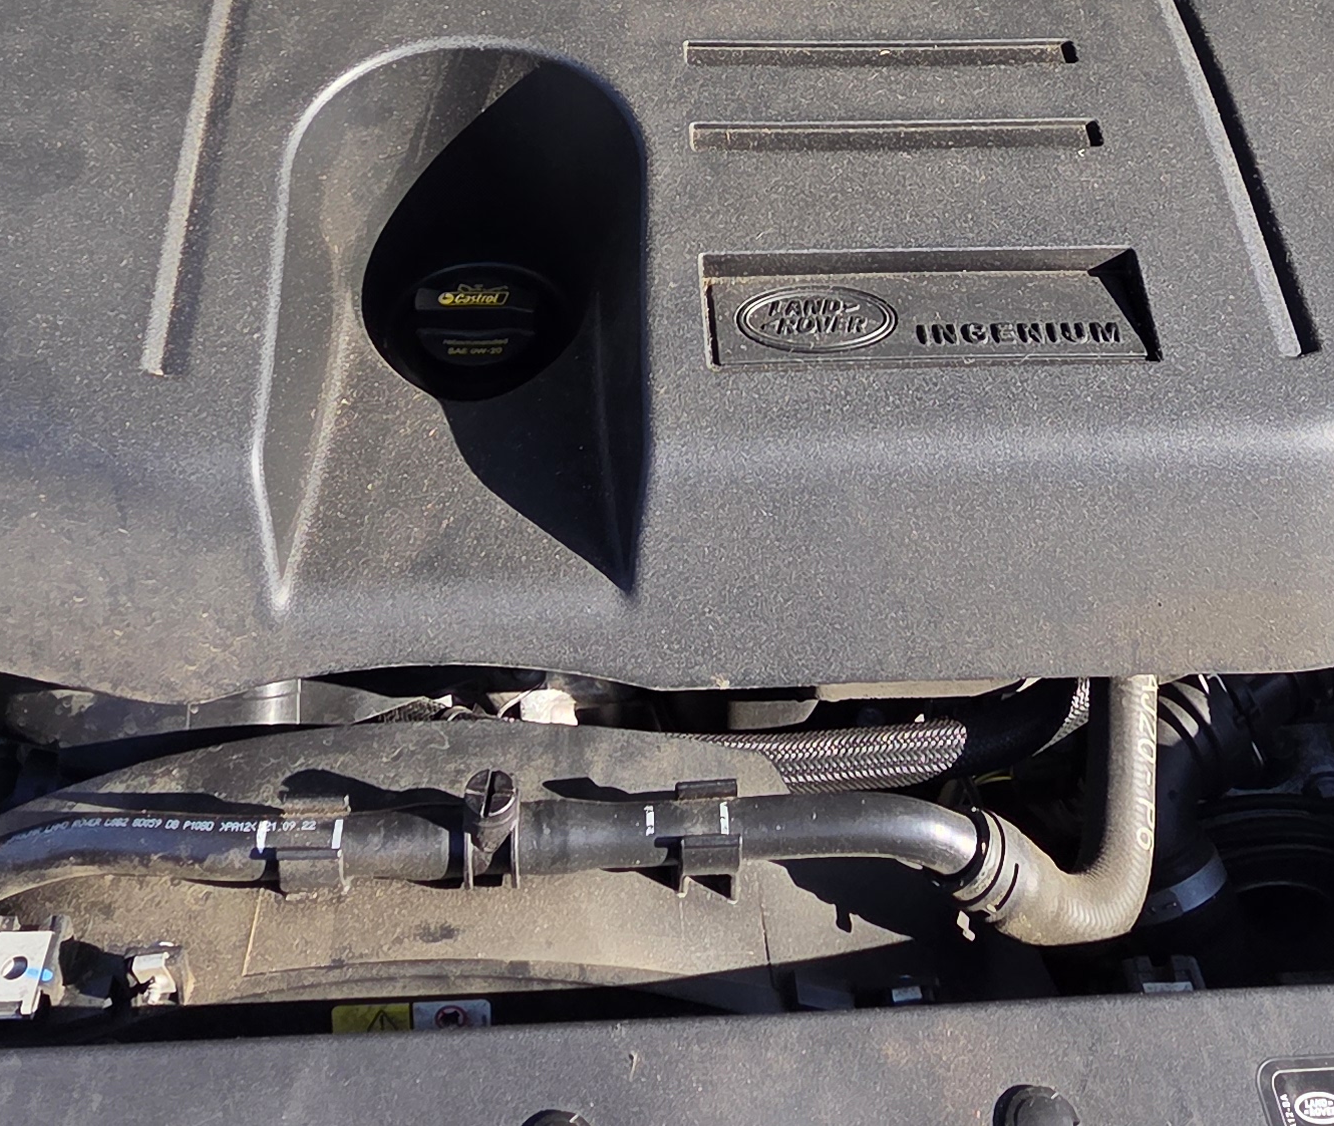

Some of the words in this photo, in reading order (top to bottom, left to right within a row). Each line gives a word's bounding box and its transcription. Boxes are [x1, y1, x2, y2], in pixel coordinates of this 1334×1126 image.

[454, 293, 498, 304] Castrol
[767, 298, 842, 316] LAND
[776, 314, 868, 336] ROVER
[914, 321, 1121, 345] INGENIUM
[447, 347, 467, 355] SAE
[1304, 1099, 1328, 1108] LAND
